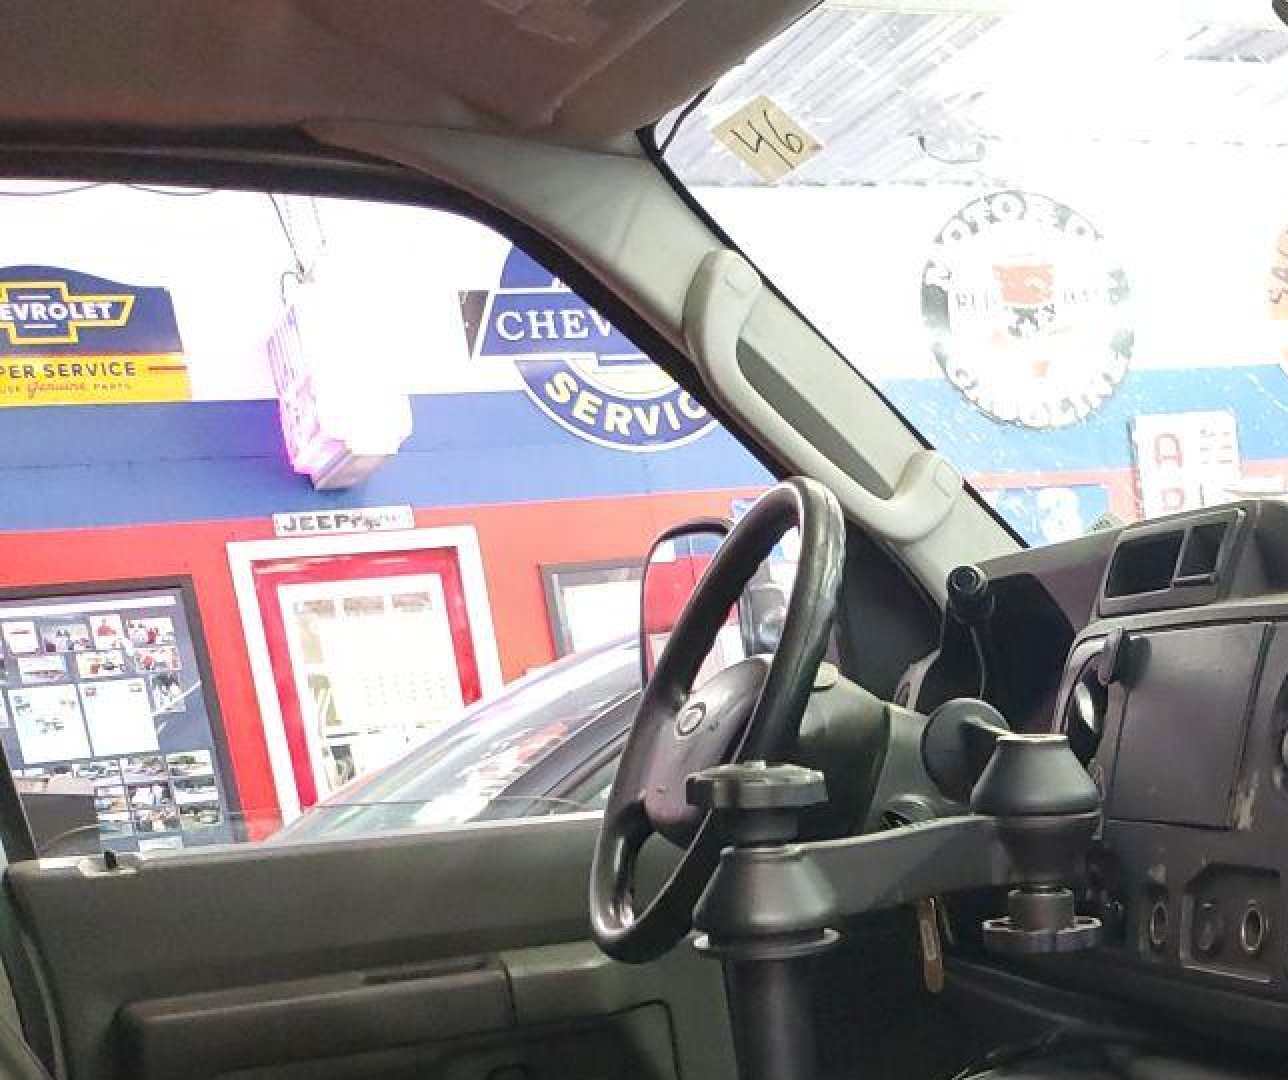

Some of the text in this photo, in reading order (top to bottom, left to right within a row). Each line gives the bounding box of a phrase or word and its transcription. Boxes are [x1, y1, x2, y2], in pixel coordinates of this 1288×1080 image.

[729, 109, 804, 170] 46
[43, 361, 136, 378] SERVICE
[283, 513, 348, 531] JEEP
